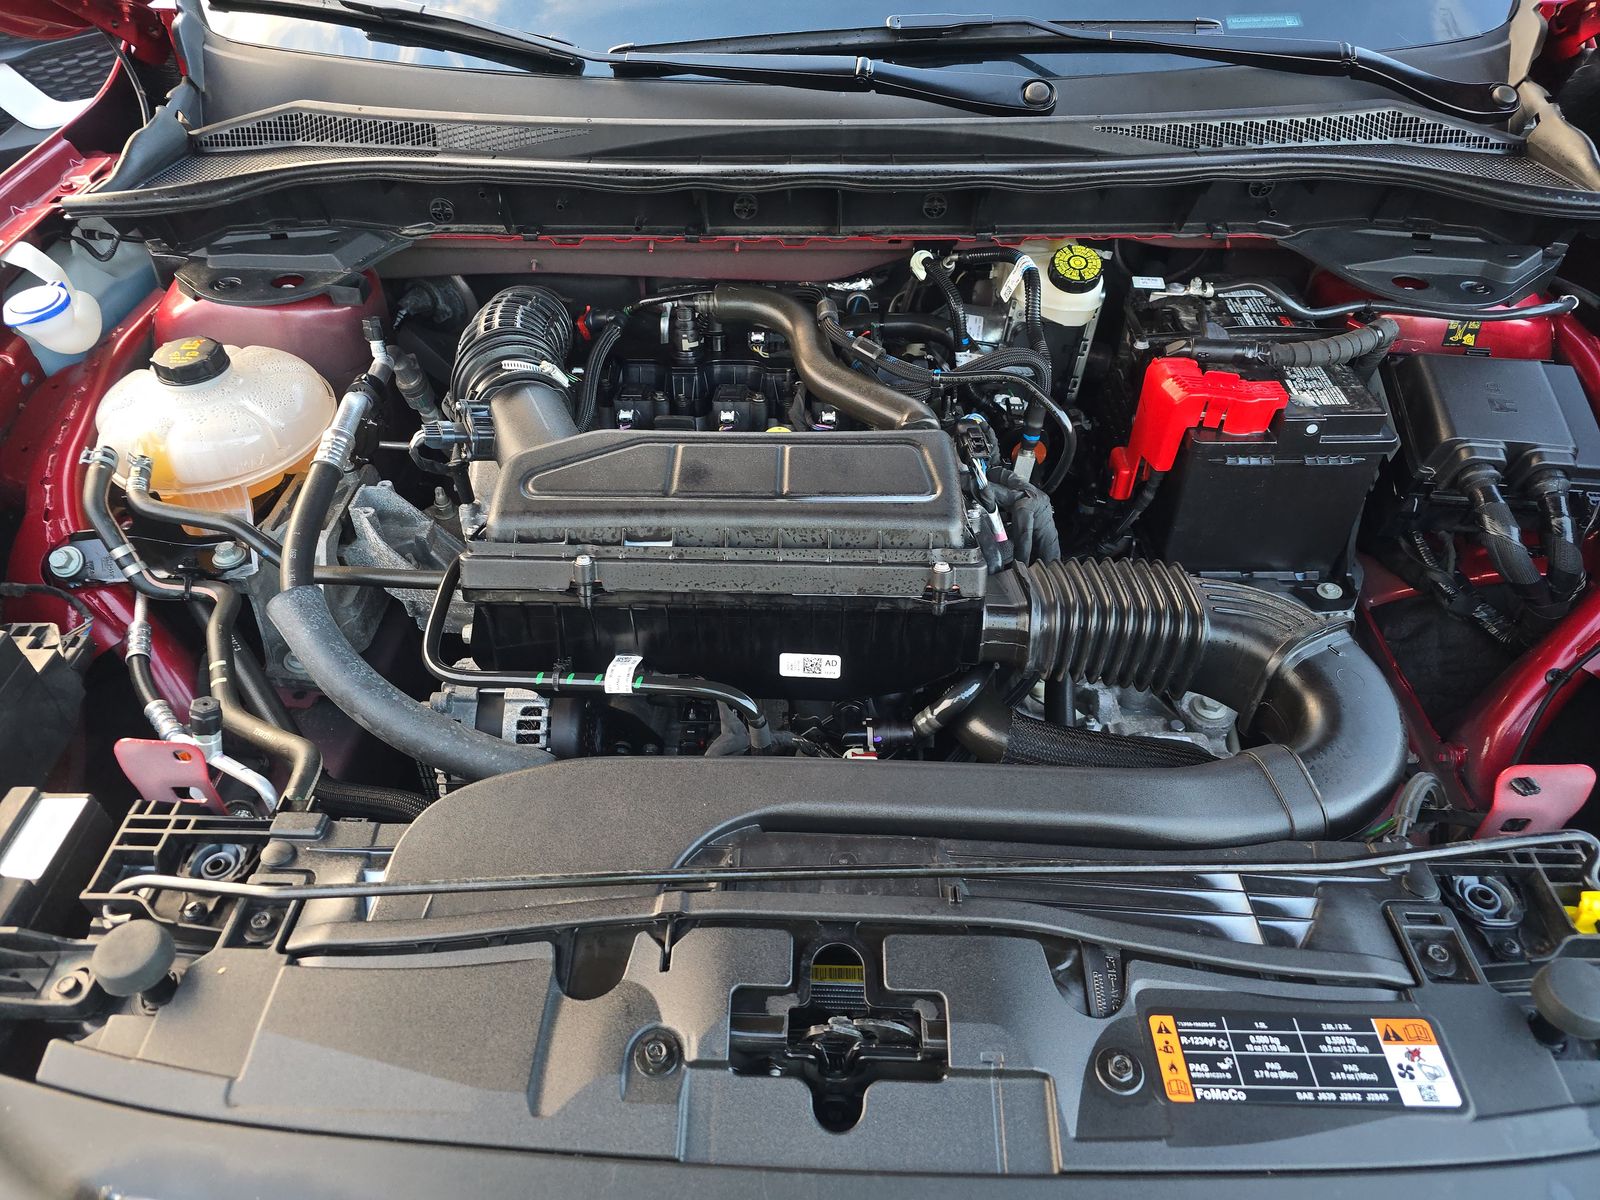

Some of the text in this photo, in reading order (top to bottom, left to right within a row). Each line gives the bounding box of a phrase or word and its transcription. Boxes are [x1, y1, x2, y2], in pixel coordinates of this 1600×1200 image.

[824, 659, 838, 667] AD
[1180, 1036, 1217, 1047] R-1234yf
[1269, 1035, 1281, 1046] kg
[1345, 1036, 1357, 1046] kg
[1188, 1063, 1209, 1072] PAG
[1265, 1062, 1282, 1071] PAG
[1342, 1063, 1360, 1072] PAG
[1195, 1087, 1247, 1101] FoMoCo
